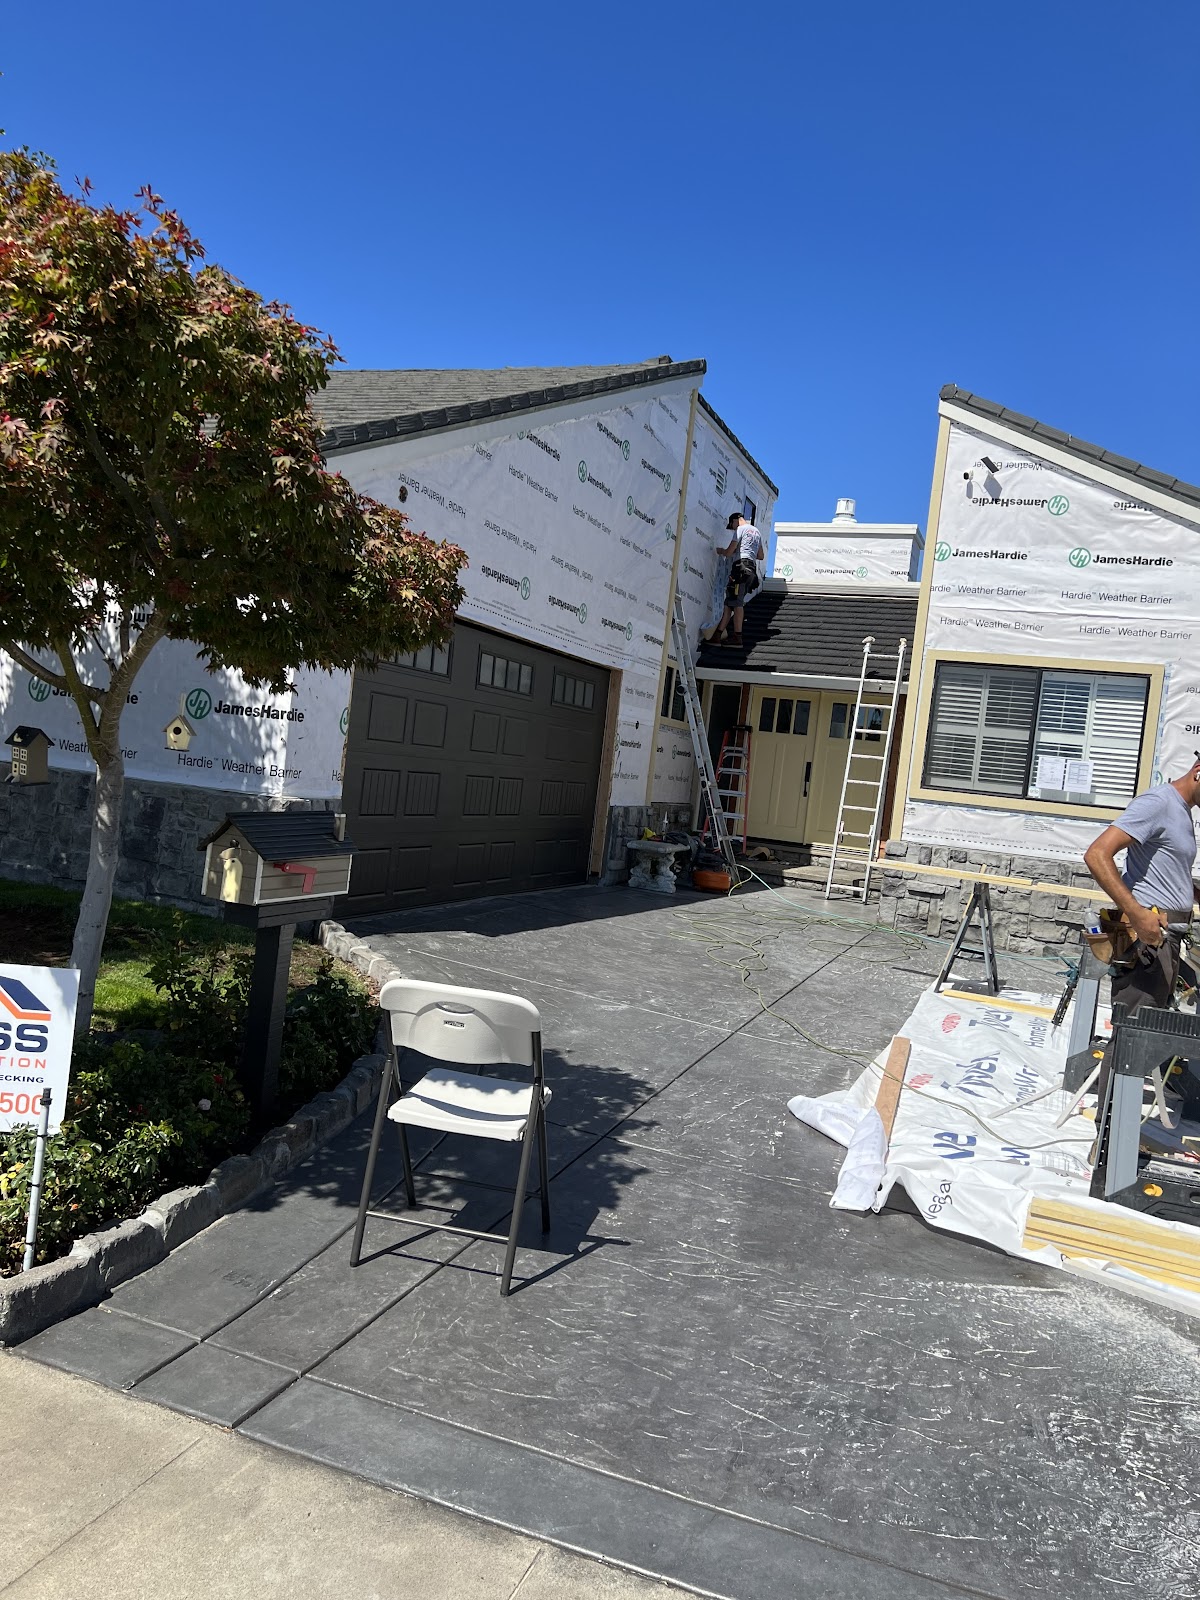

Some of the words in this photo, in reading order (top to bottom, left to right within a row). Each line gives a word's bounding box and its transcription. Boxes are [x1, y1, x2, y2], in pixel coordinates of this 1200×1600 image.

[952, 548, 1028, 561] JamesHardie
[1092, 554, 1174, 567] JamesHardie
[958, 585, 995, 596] Weather
[996, 586, 1027, 597] Barrier
[1099, 592, 1137, 603] Weather
[1140, 594, 1173, 605] Barrier
[975, 619, 1012, 630] Weather
[1014, 622, 1044, 632] Barrier
[1118, 627, 1159, 639] Weather
[1160, 629, 1193, 641] Barrier
[214, 700, 304, 723] JamesHardie
[221, 759, 266, 777] Weather
[269, 765, 302, 780] Barrier
